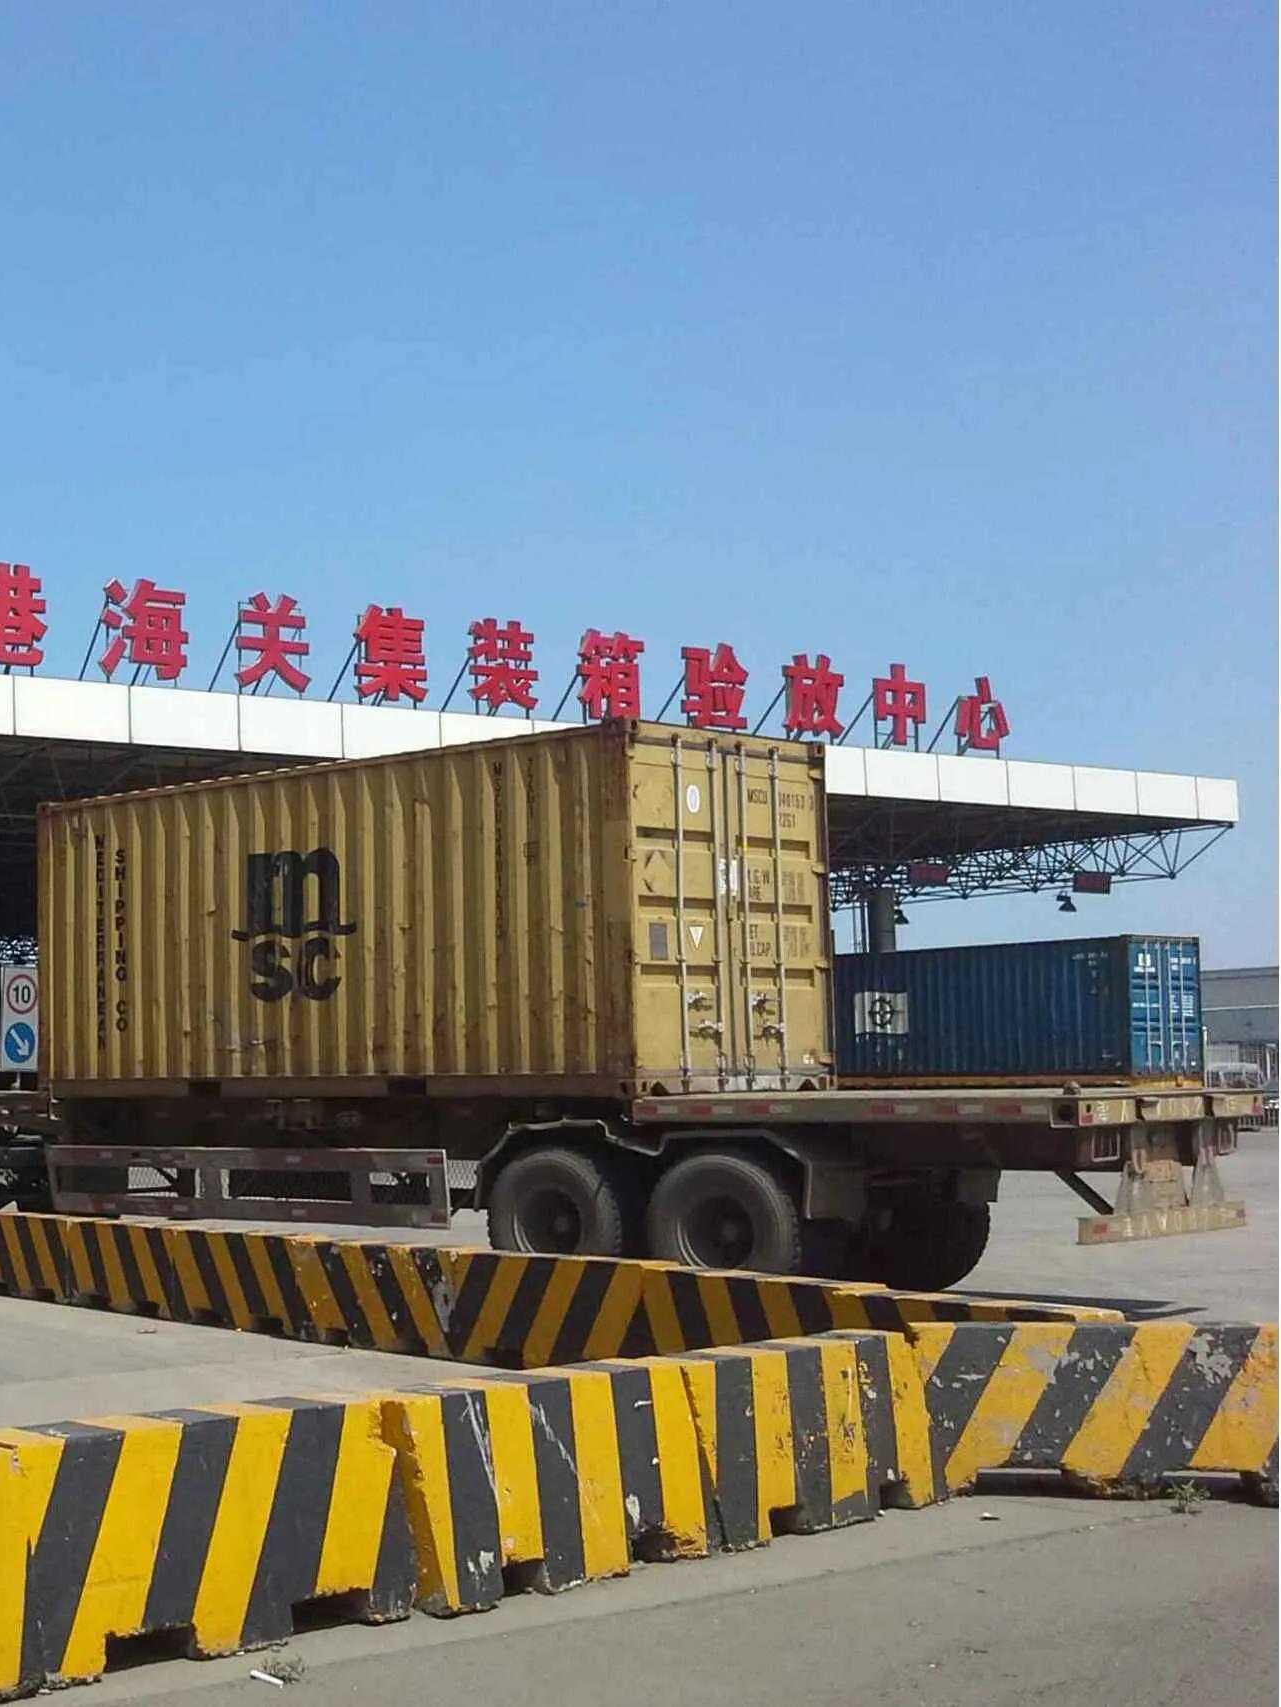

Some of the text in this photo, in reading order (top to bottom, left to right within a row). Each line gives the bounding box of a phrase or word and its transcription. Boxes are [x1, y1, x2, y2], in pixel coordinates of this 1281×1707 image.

[115, 849, 128, 1033] SHIPPING CO
[12, 984, 32, 1004] 10
